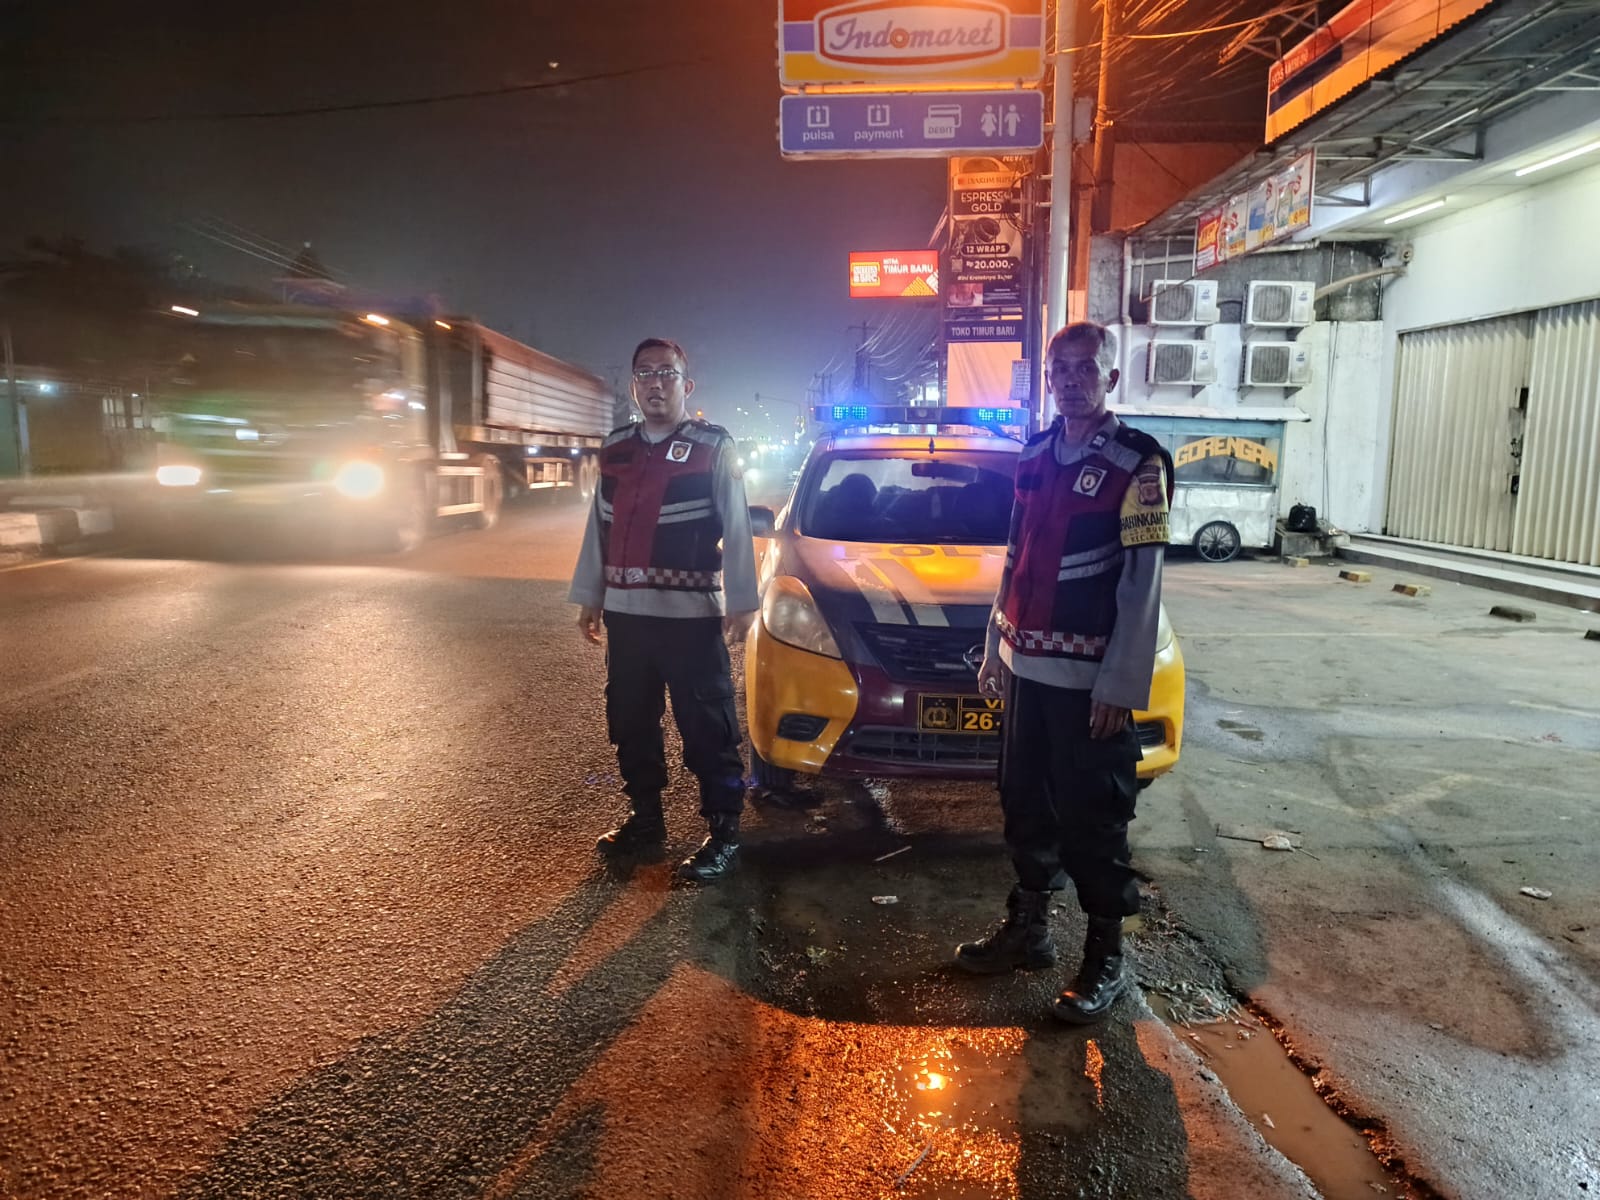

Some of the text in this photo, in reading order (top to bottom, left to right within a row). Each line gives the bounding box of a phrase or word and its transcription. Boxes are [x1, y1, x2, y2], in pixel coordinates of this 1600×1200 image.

[829, 17, 994, 50] Indomaret
[803, 130, 835, 142] pulsa
[854, 128, 904, 142] payment
[928, 126, 953, 135] DEBIT
[971, 203, 1002, 213] GOLD
[966, 245, 1006, 254] 12 WRAPS
[883, 264, 909, 274] TIMUR
[910, 263, 934, 273] BARU
[951, 326, 1016, 337] TOKO TIMUR BARU
[1174, 435, 1278, 473] GORENGAN
